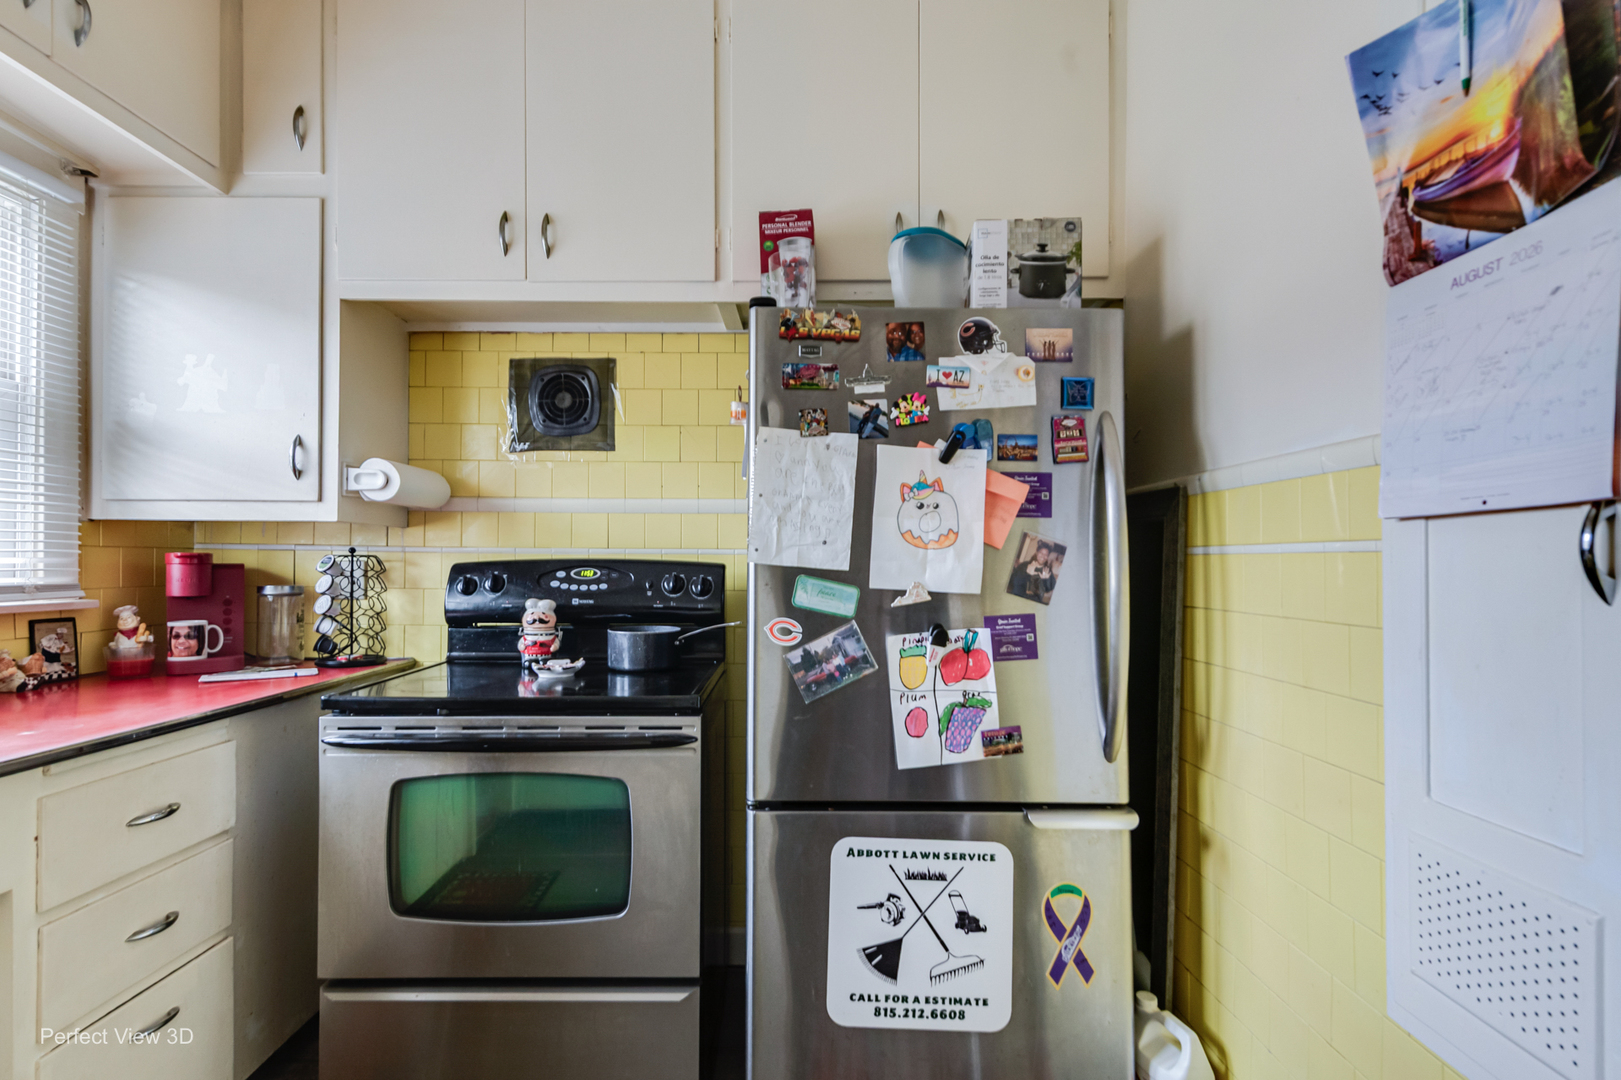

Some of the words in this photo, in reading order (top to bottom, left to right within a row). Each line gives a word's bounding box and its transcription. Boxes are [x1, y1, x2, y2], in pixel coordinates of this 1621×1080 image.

[761, 222, 788, 230] PERSONAL
[1450, 256, 1504, 291] AUGUST
[1508, 240, 1544, 267] 2026
[779, 326, 809, 339] LS
[811, 327, 861, 340] VEGAS
[953, 369, 965, 384] AZ
[895, 414, 929, 427] FLORIDA
[846, 847, 899, 859] ABBOTT
[902, 850, 941, 860] LAWN
[943, 852, 997, 862] SERVICE
[849, 992, 881, 1003] CALL
[884, 994, 909, 1004] FOR
[912, 995, 921, 1005] A
[924, 996, 989, 1007] ESTIMATE
[873, 1006, 966, 1021] 815.212.6608
